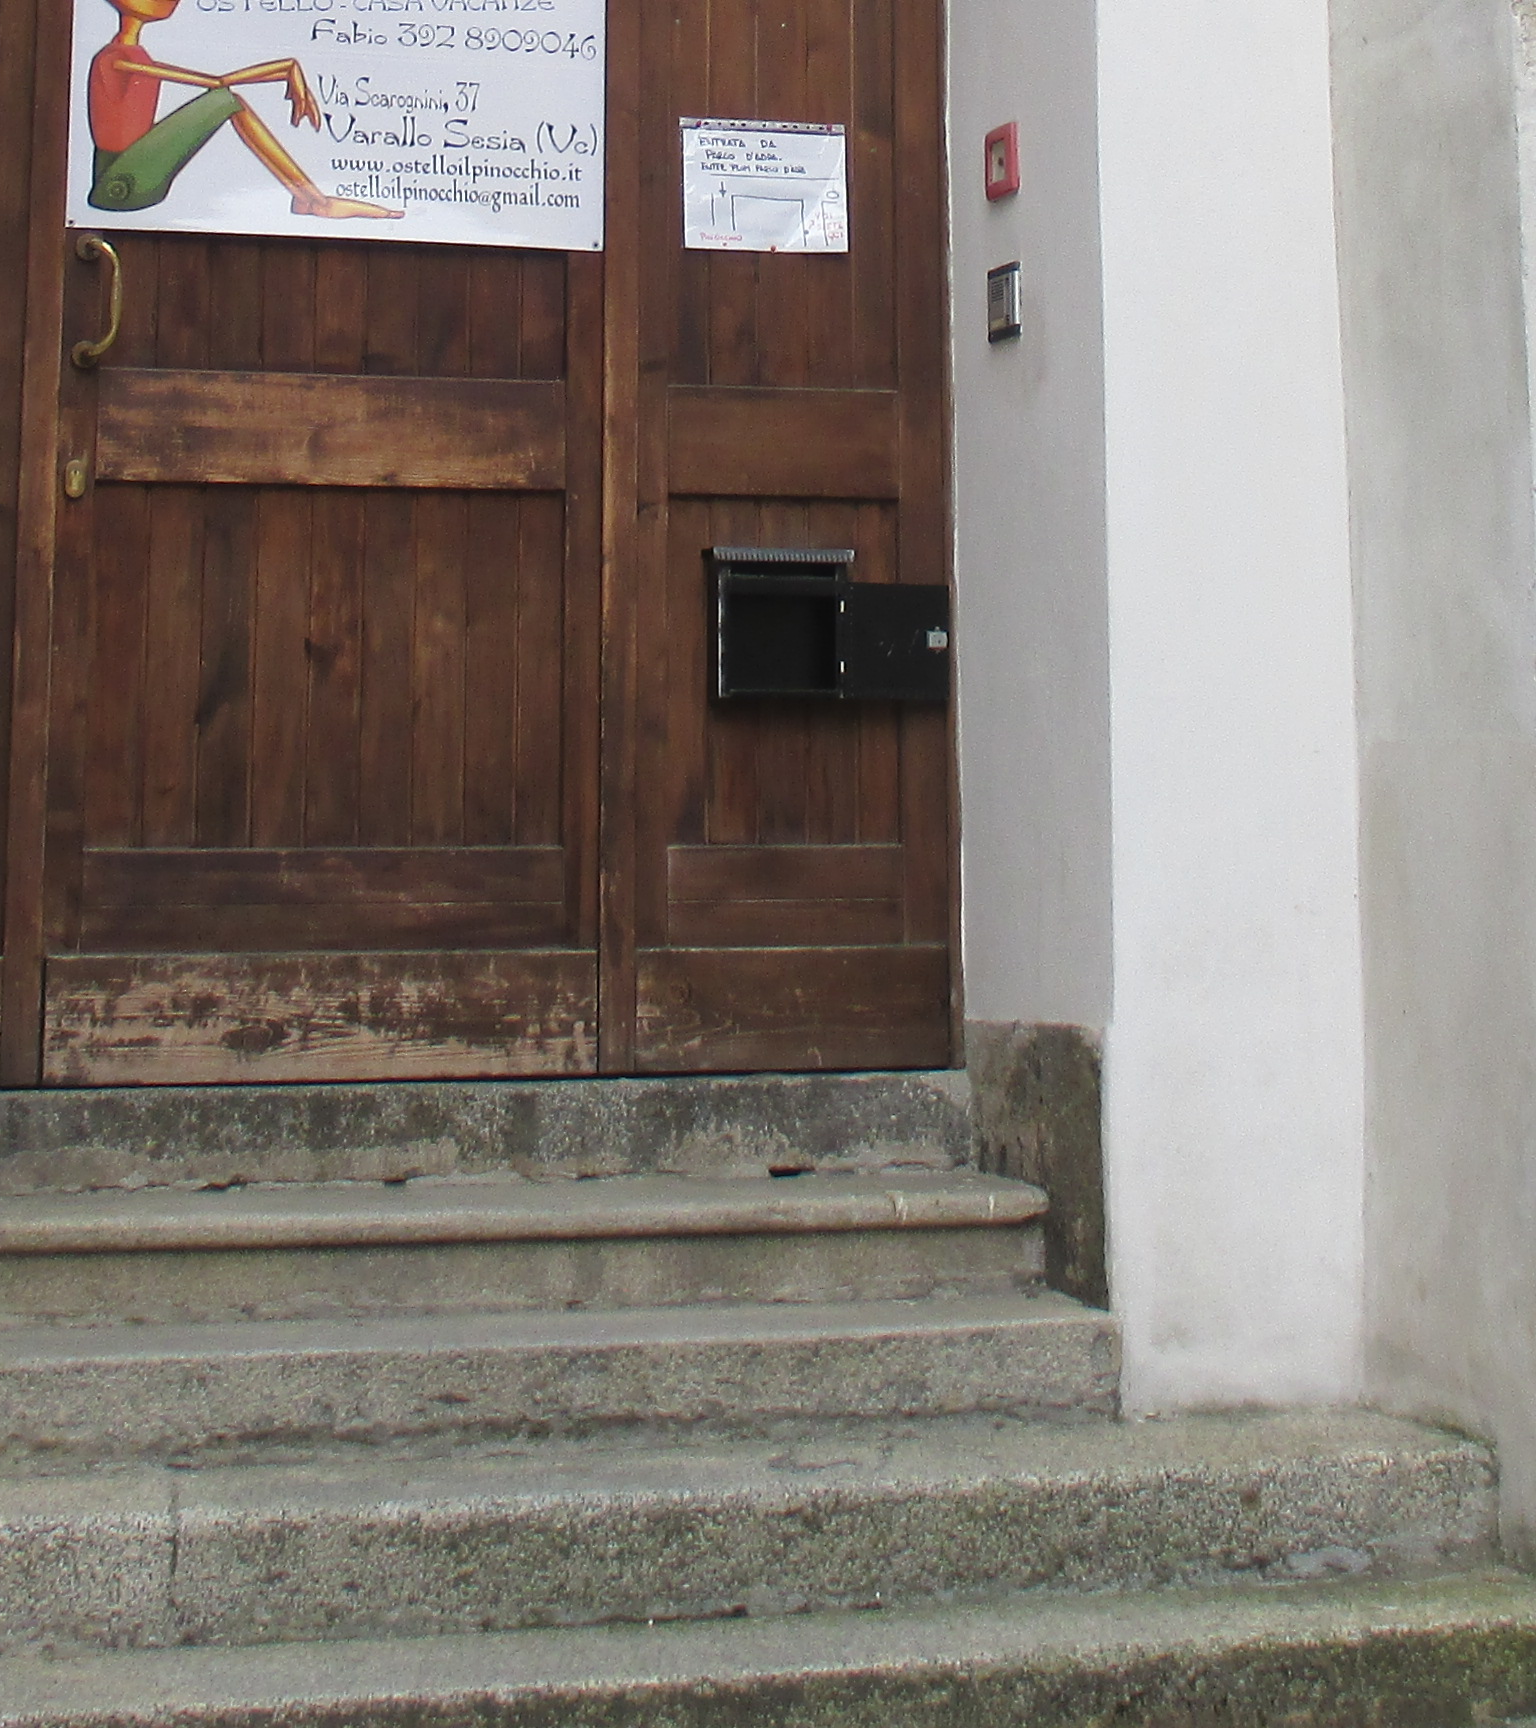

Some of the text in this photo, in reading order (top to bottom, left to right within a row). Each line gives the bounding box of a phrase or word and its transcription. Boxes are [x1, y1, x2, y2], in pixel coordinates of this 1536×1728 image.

[311, 18, 598, 61] Fabio 392 8909046
[318, 74, 481, 114] Via Scarognini, 37
[323, 112, 599, 157] Varallo Sesia (Vc)
[760, 139, 777, 149] DA
[331, 154, 583, 184] www.ostelloilpinocchio.it
[335, 175, 581, 214] ostelloilpinocchio@gmail.com
